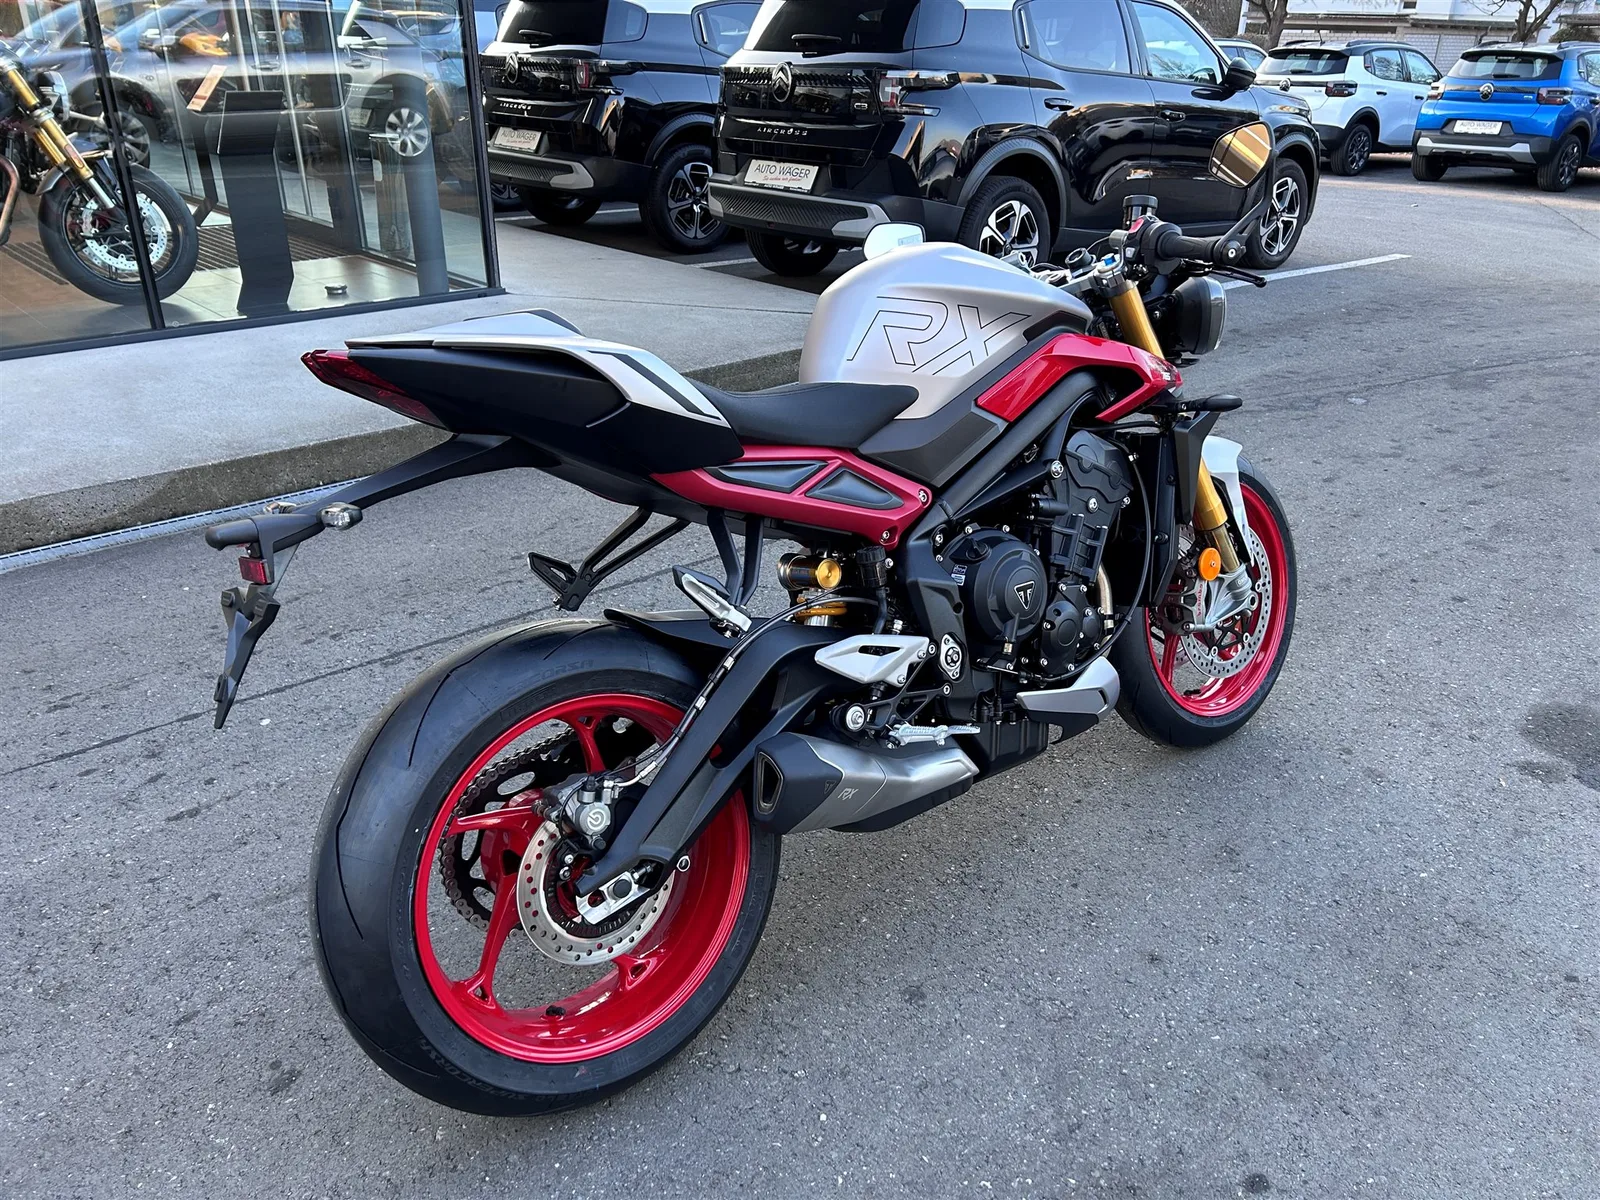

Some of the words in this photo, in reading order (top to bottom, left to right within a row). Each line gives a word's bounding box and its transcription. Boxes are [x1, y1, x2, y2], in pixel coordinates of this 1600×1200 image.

[854, 102, 868, 110] C3
[501, 129, 516, 138] AUTO
[756, 127, 808, 136] AIRCROSS
[754, 163, 777, 175] AUTO
[846, 296, 1032, 376] RX
[837, 787, 859, 801] RX
